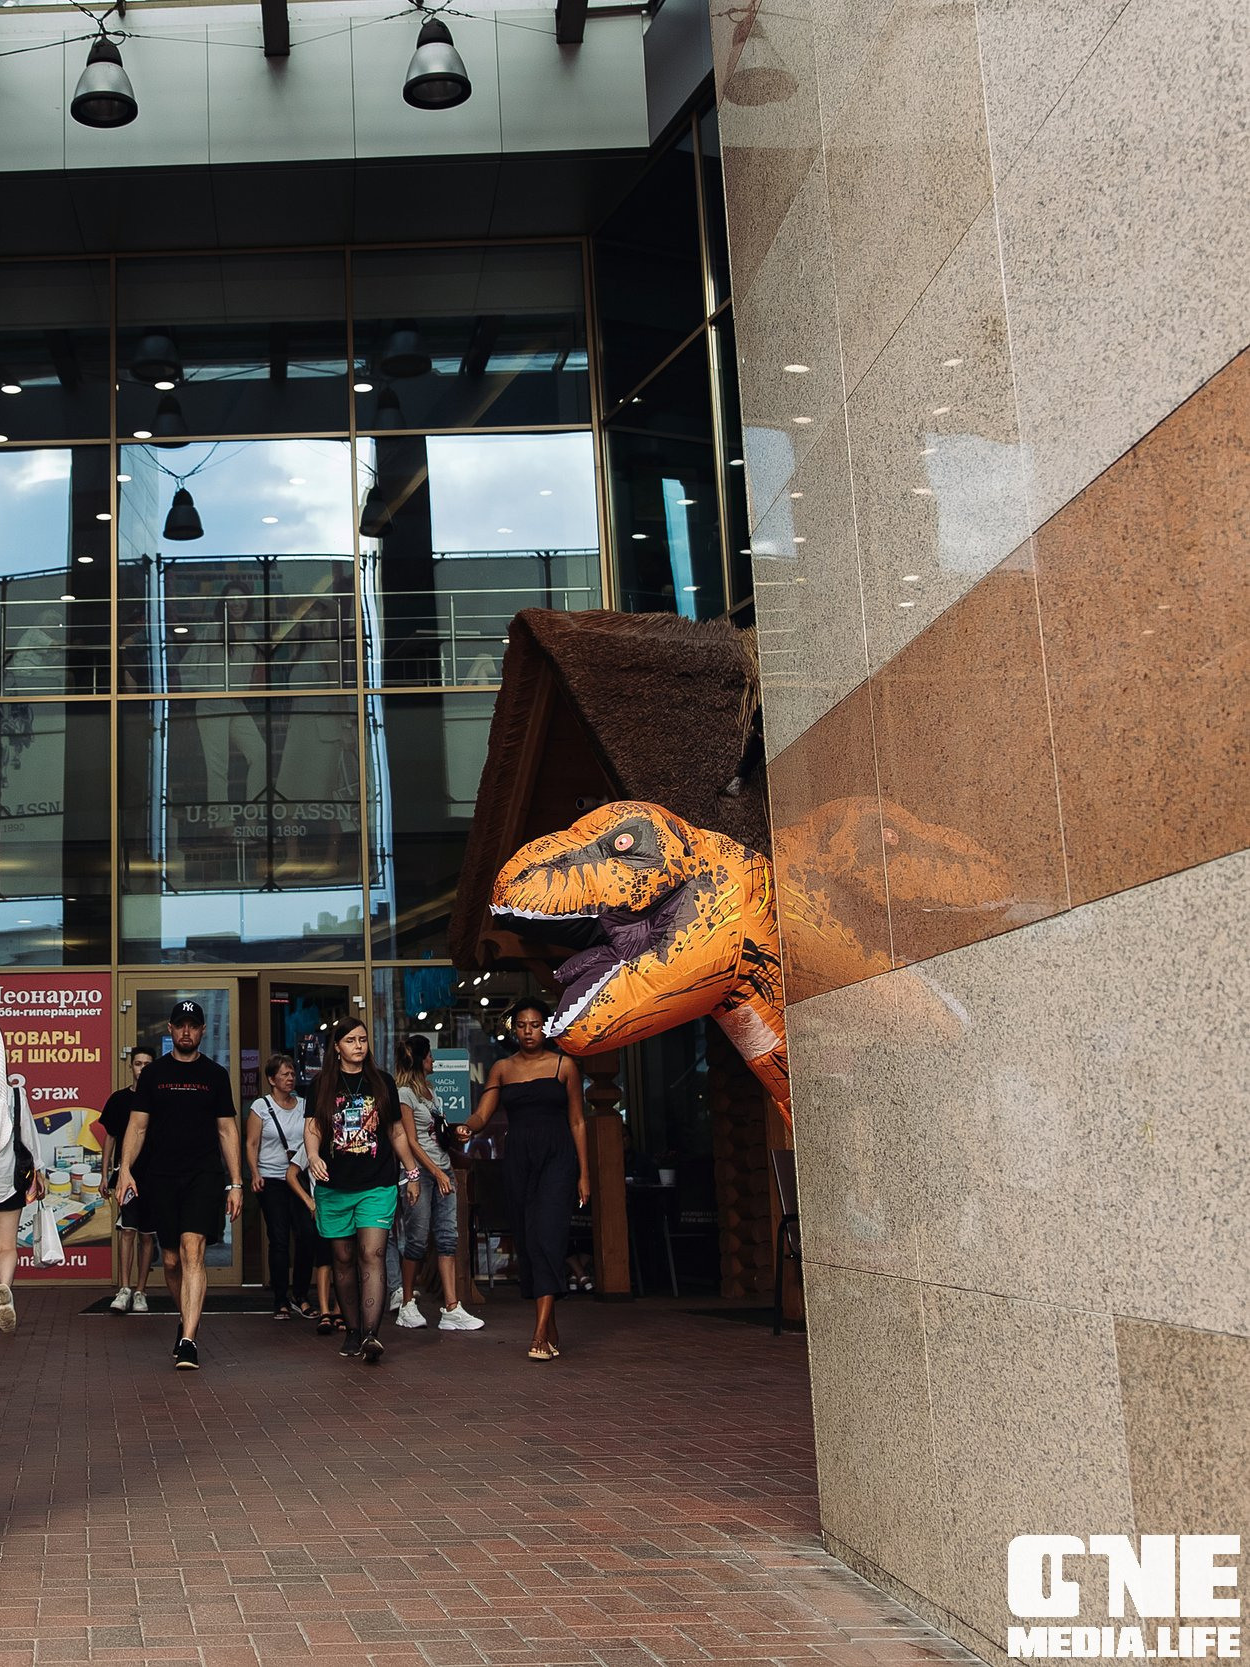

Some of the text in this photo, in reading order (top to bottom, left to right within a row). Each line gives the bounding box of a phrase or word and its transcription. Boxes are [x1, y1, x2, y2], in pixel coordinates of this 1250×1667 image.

[276, 825, 307, 837] 1890
[4, 1031, 80, 1046] ТОВАРЫ
[6, 1049, 101, 1063] Я ШКОЛЫ
[31, 1088, 79, 1100] этаж
